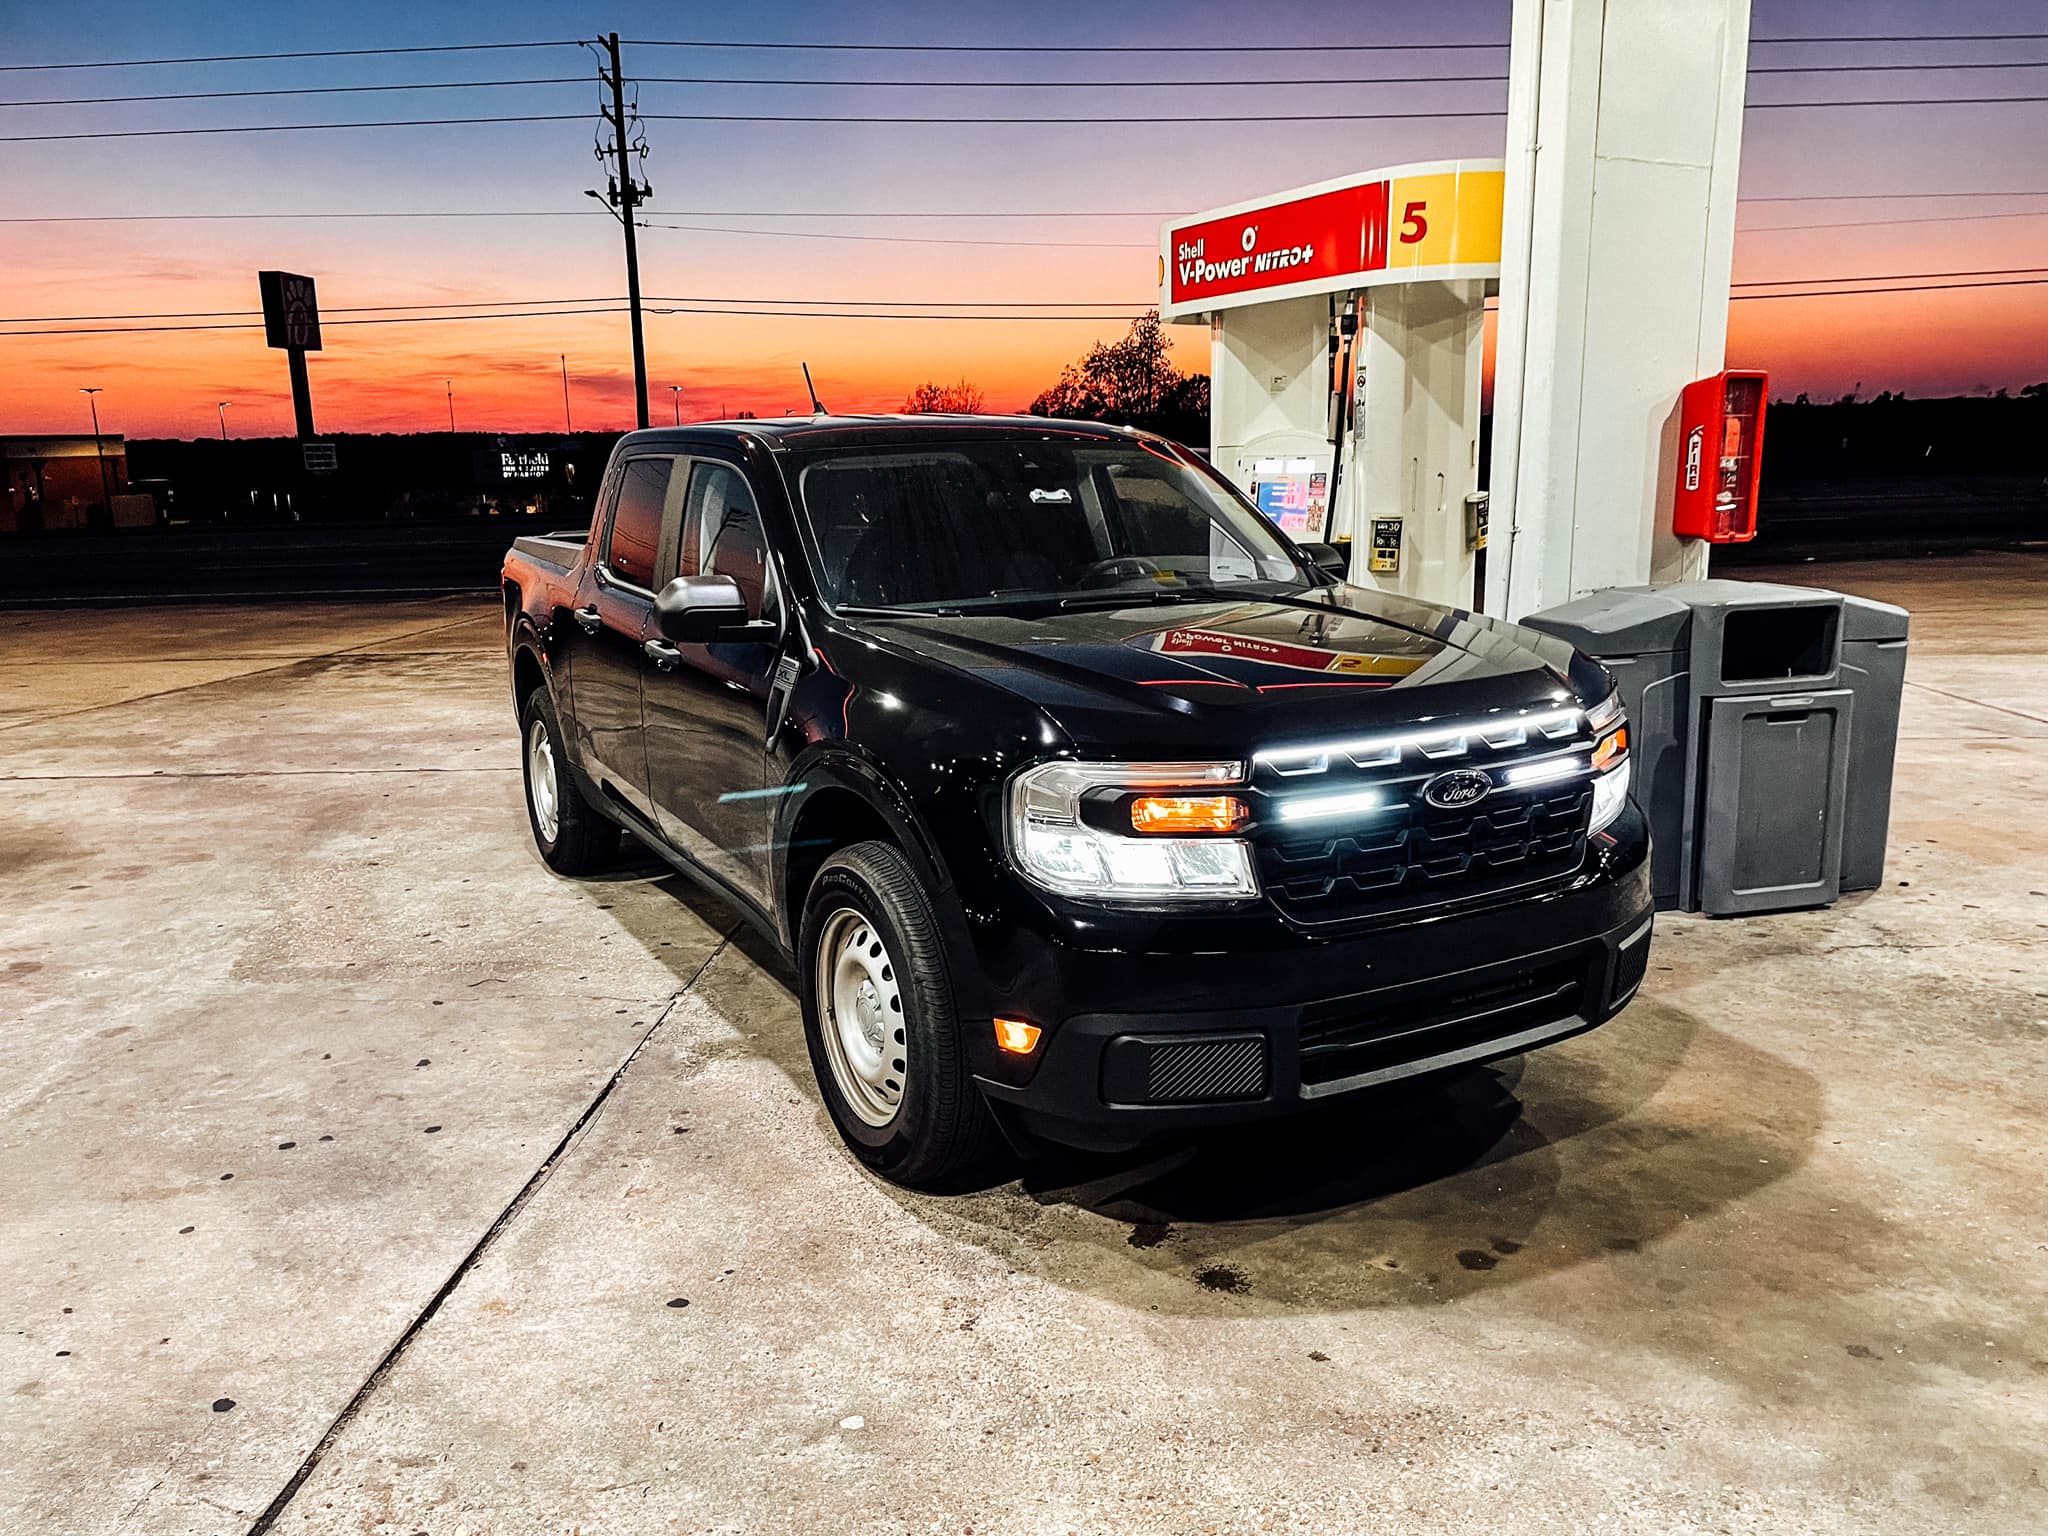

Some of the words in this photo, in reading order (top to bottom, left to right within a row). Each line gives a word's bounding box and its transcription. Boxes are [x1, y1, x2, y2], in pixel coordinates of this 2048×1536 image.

[1400, 201, 1428, 244] 5
[1178, 238, 1204, 261] Shell
[1179, 256, 1250, 286] V-Power
[1689, 442, 1699, 486] FIRE
[1443, 783, 1478, 801] Ford
